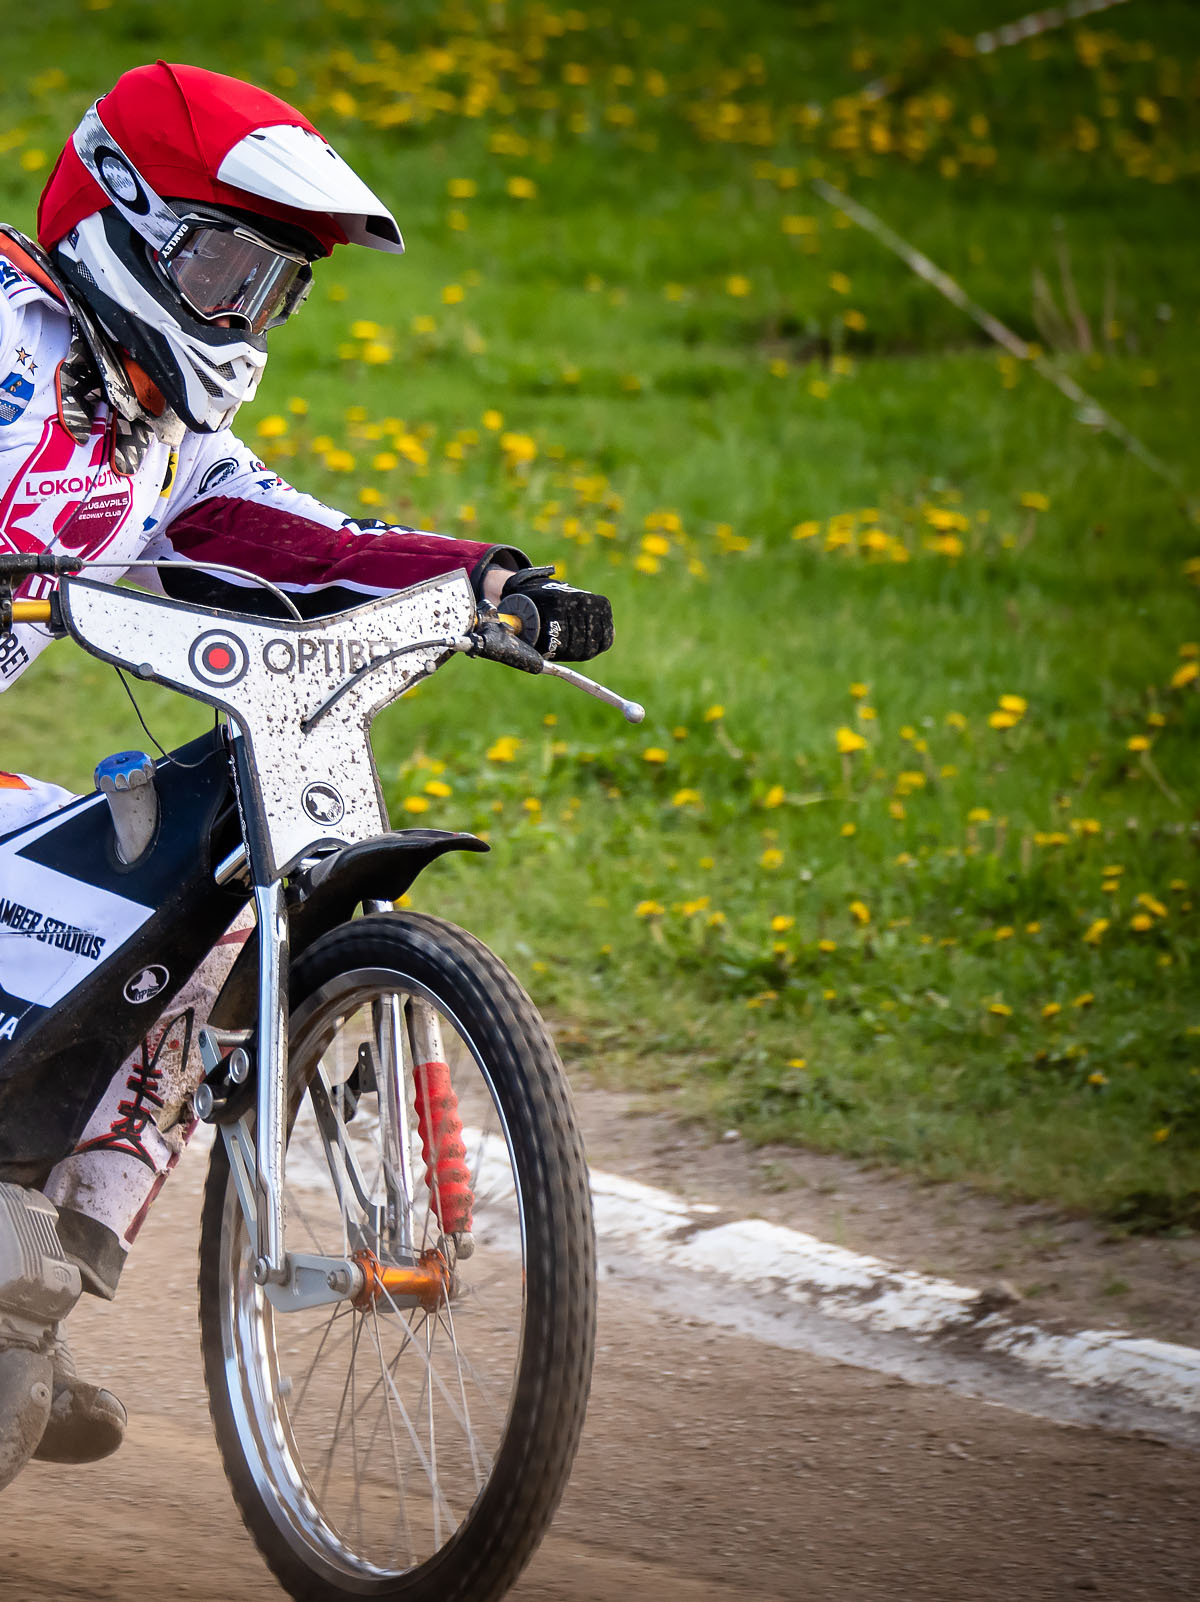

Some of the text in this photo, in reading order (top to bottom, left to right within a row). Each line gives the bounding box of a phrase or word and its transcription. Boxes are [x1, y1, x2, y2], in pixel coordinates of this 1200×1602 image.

[161, 223, 189, 259] OAKLEY
[82, 497, 129, 514] UGAVPILS
[262, 638, 398, 677] OPTIBET
[36, 916, 107, 961] STUDIOS
